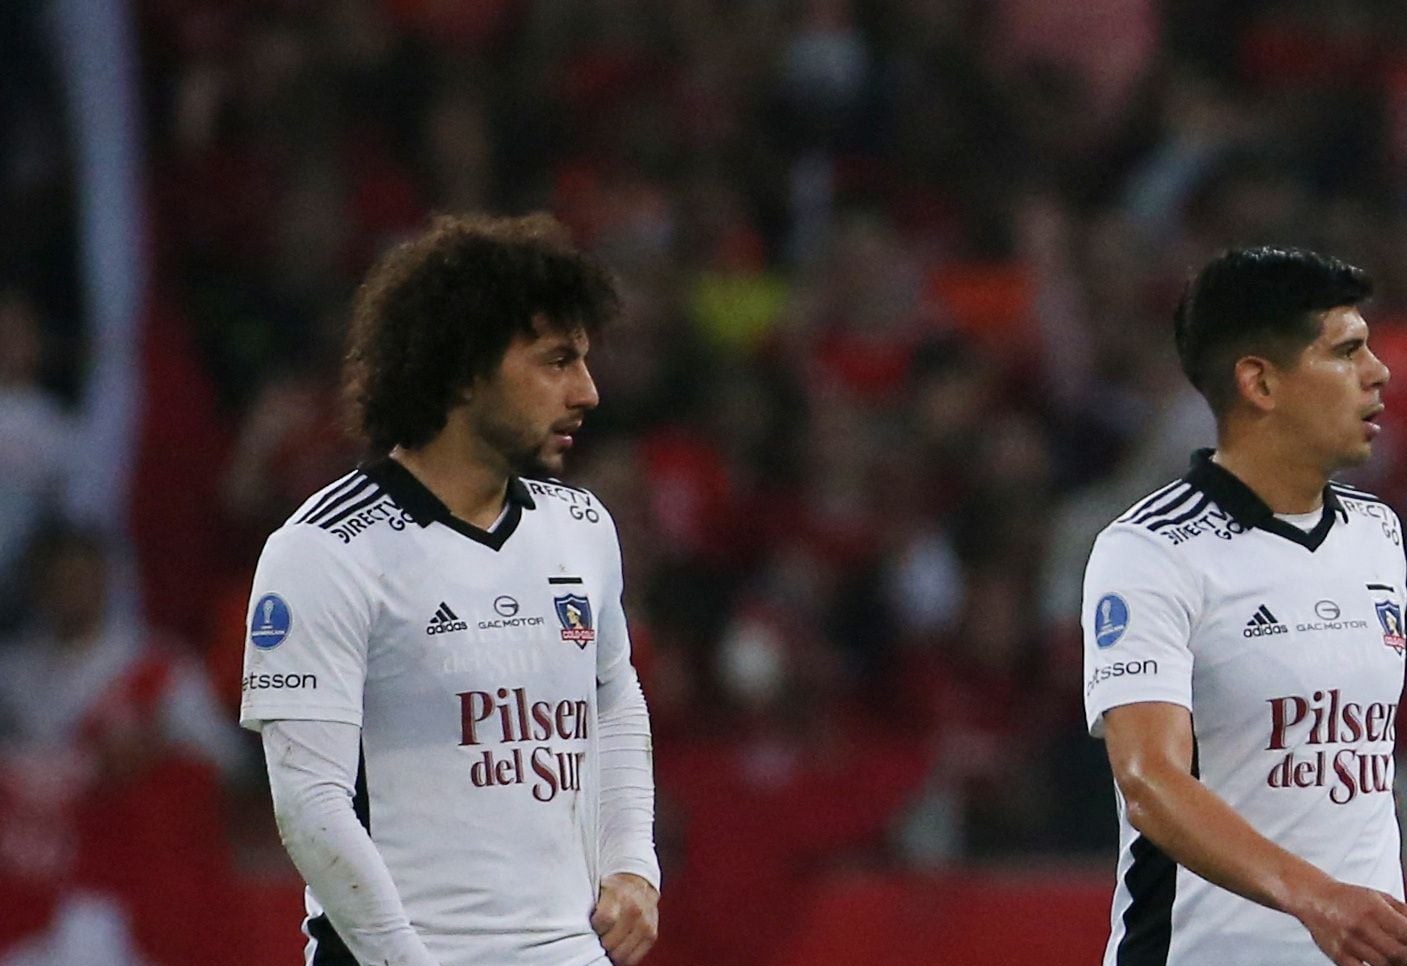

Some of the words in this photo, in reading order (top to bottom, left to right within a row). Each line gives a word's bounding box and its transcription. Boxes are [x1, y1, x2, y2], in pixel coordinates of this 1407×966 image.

[389, 508, 416, 532] GO
[570, 505, 600, 523] GO
[1214, 520, 1246, 541] GO
[426, 621, 468, 635] adidas
[1243, 624, 1288, 638] adidas
[456, 687, 588, 746] Pilsen
[470, 748, 525, 788] del
[530, 746, 585, 802] Sur
[1267, 751, 1326, 788] del
